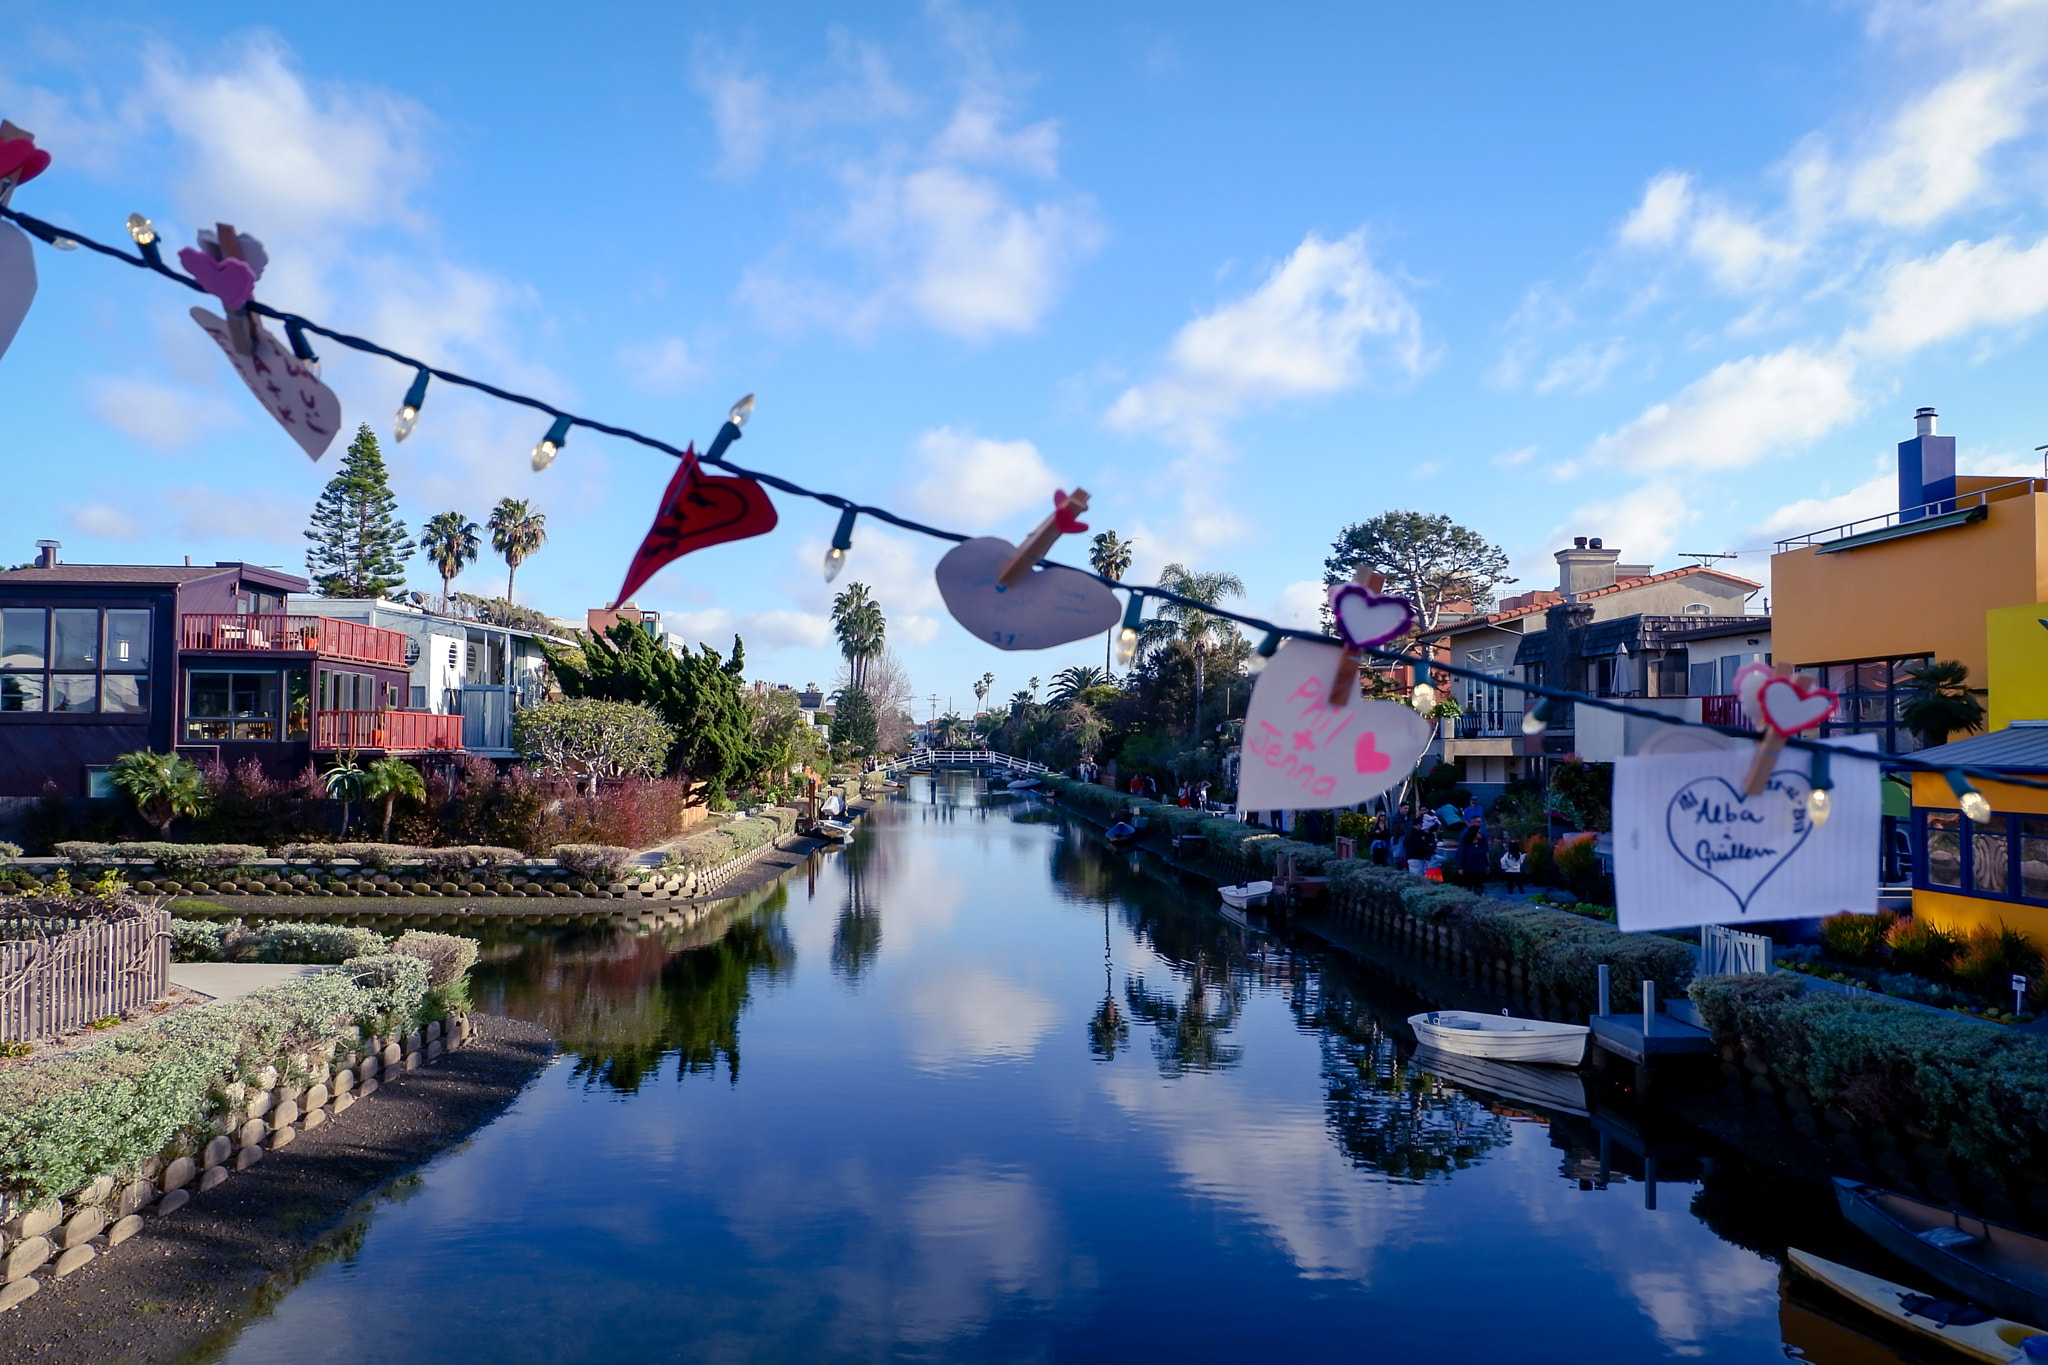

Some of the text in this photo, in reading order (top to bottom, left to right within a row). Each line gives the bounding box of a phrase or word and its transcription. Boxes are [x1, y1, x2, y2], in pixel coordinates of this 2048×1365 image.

[1287, 676, 1356, 747] Phil
[1247, 720, 1338, 799] Jenna
[1695, 797, 1765, 825] Alba
